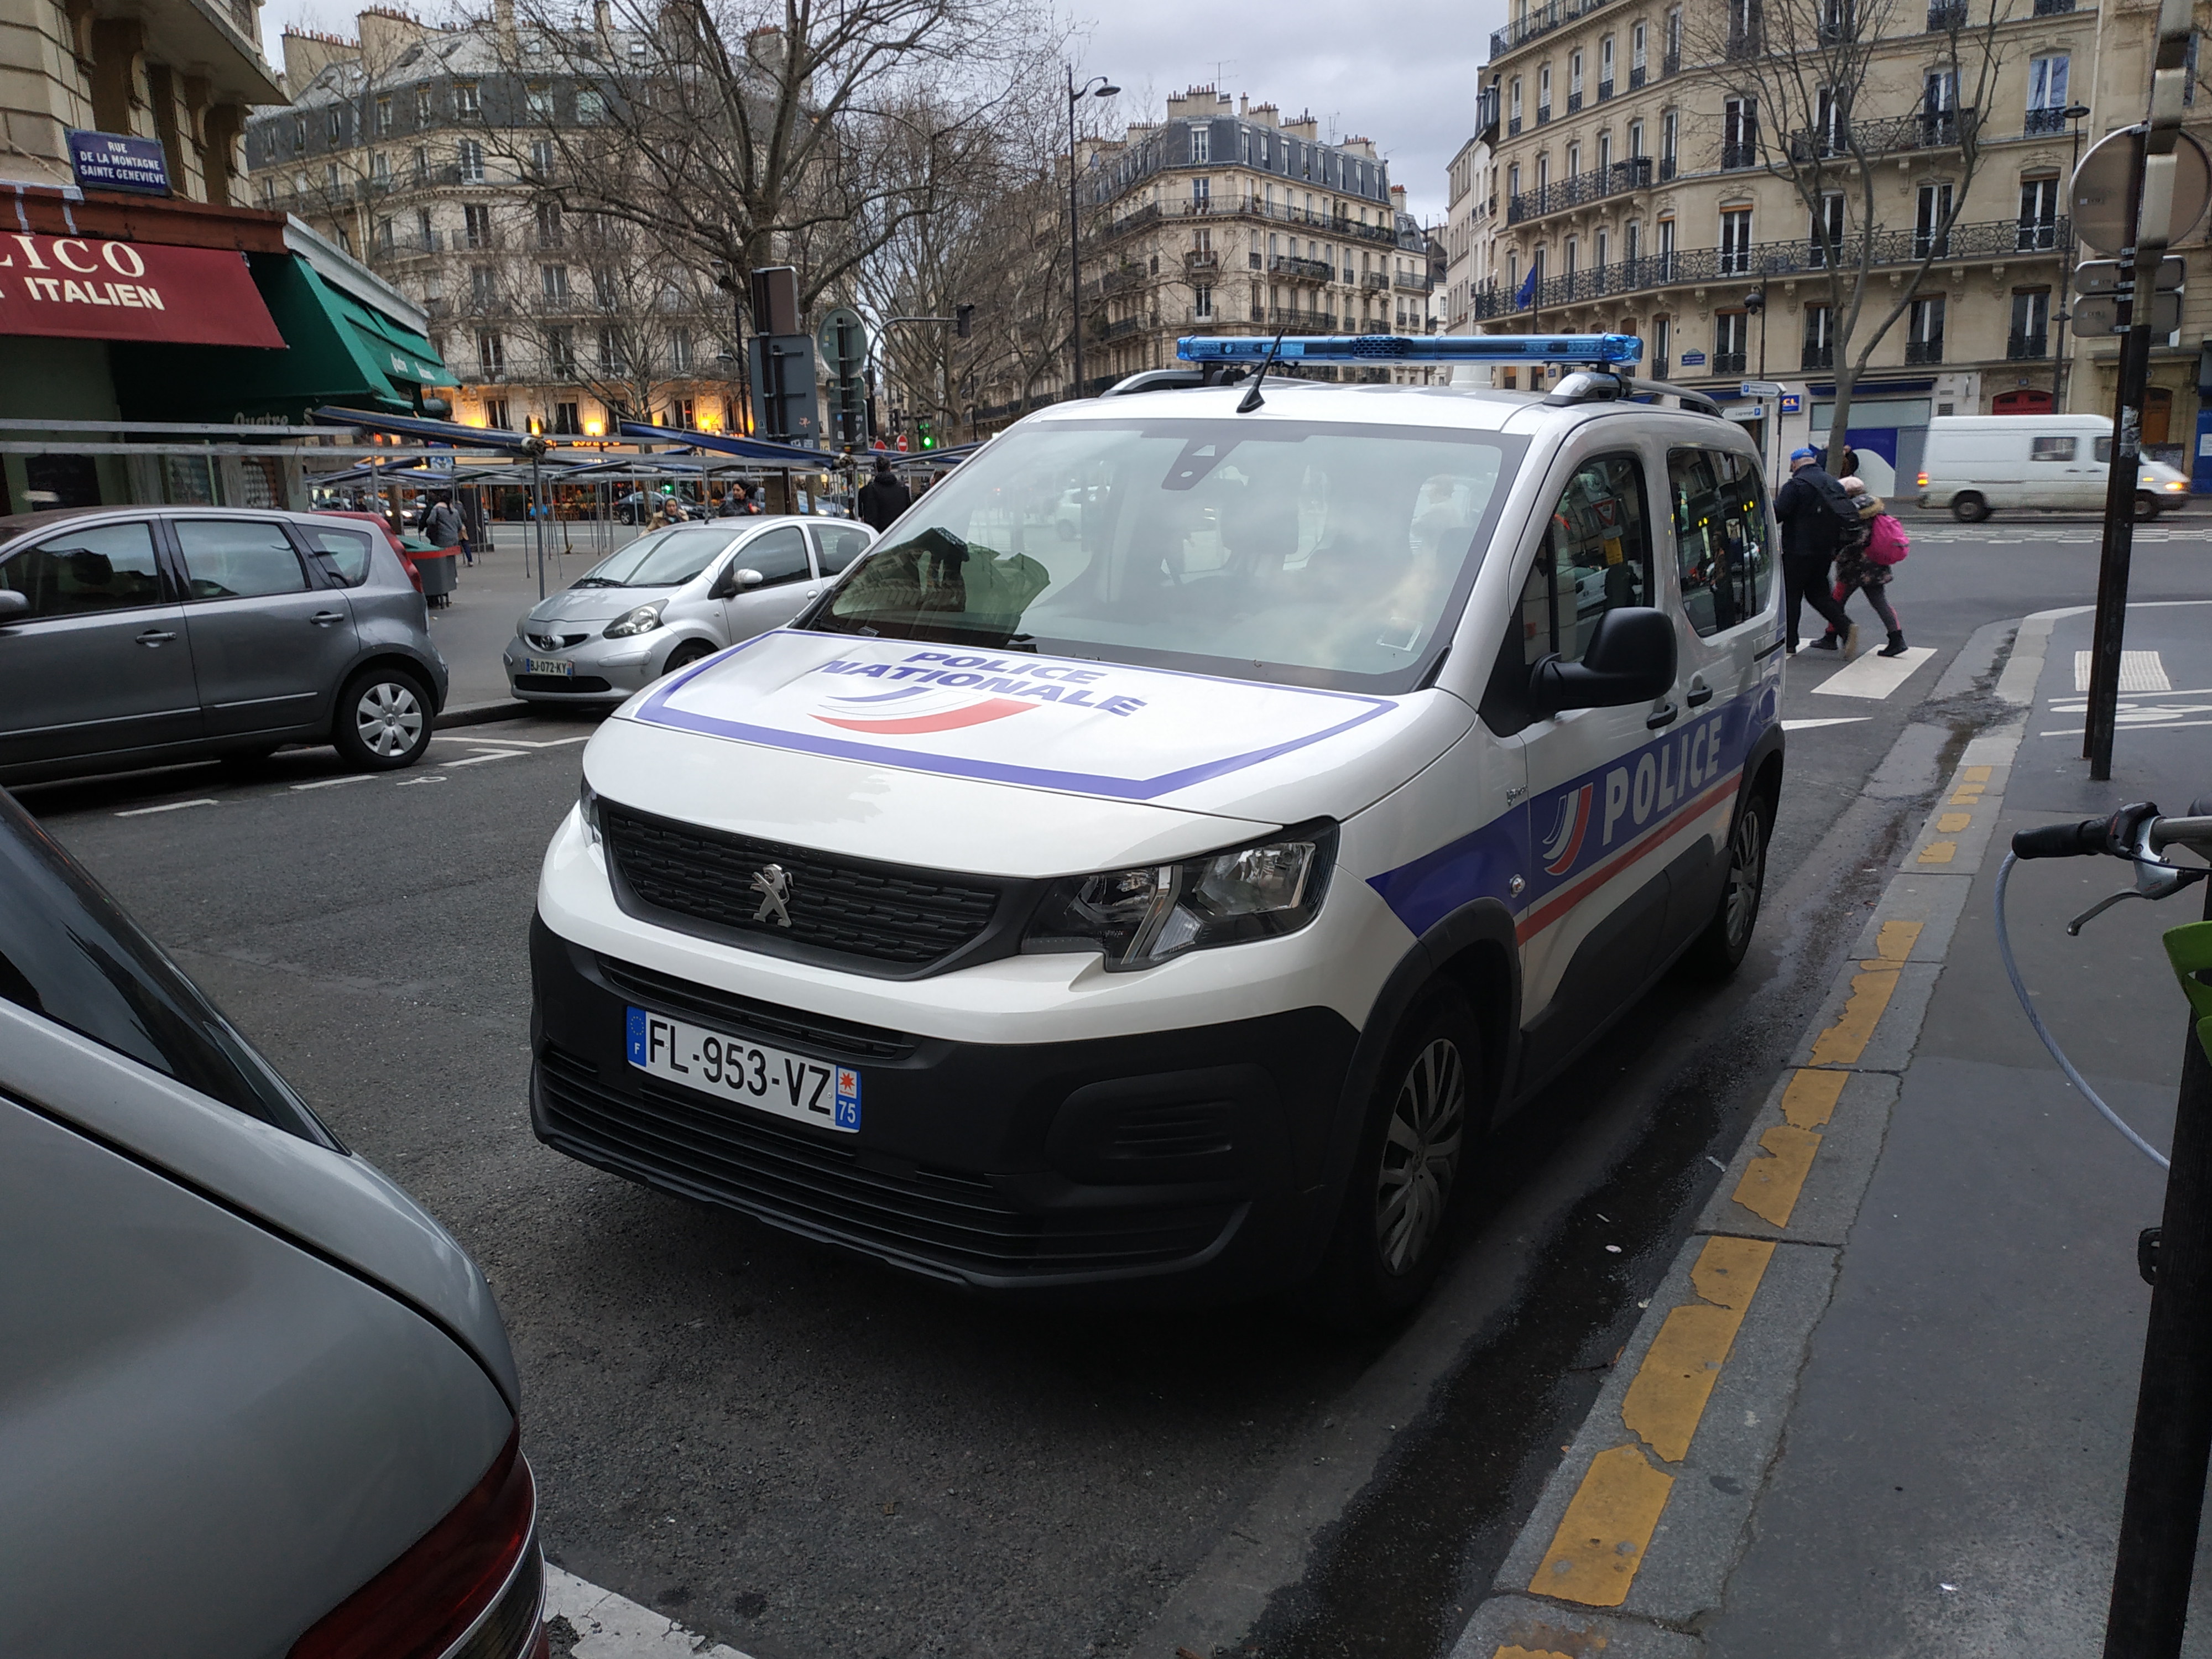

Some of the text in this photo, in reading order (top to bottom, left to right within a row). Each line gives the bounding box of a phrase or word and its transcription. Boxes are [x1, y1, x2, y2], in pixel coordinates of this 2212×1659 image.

[107, 142, 128, 154] RUE
[80, 151, 161, 171] DE LA MONTAGNE
[80, 165, 115, 178] SAINTE
[24, 276, 165, 311] ITALIEN
[530, 660, 566, 674] BJ-072-KY
[901, 651, 1108, 685] POLICE
[821, 660, 1149, 718] NATIONALE
[1602, 714, 1723, 846] POLICE
[634, 1042, 640, 1055] F
[650, 1019, 831, 1116] FL-953-VZ
[838, 1100, 856, 1123] 75
